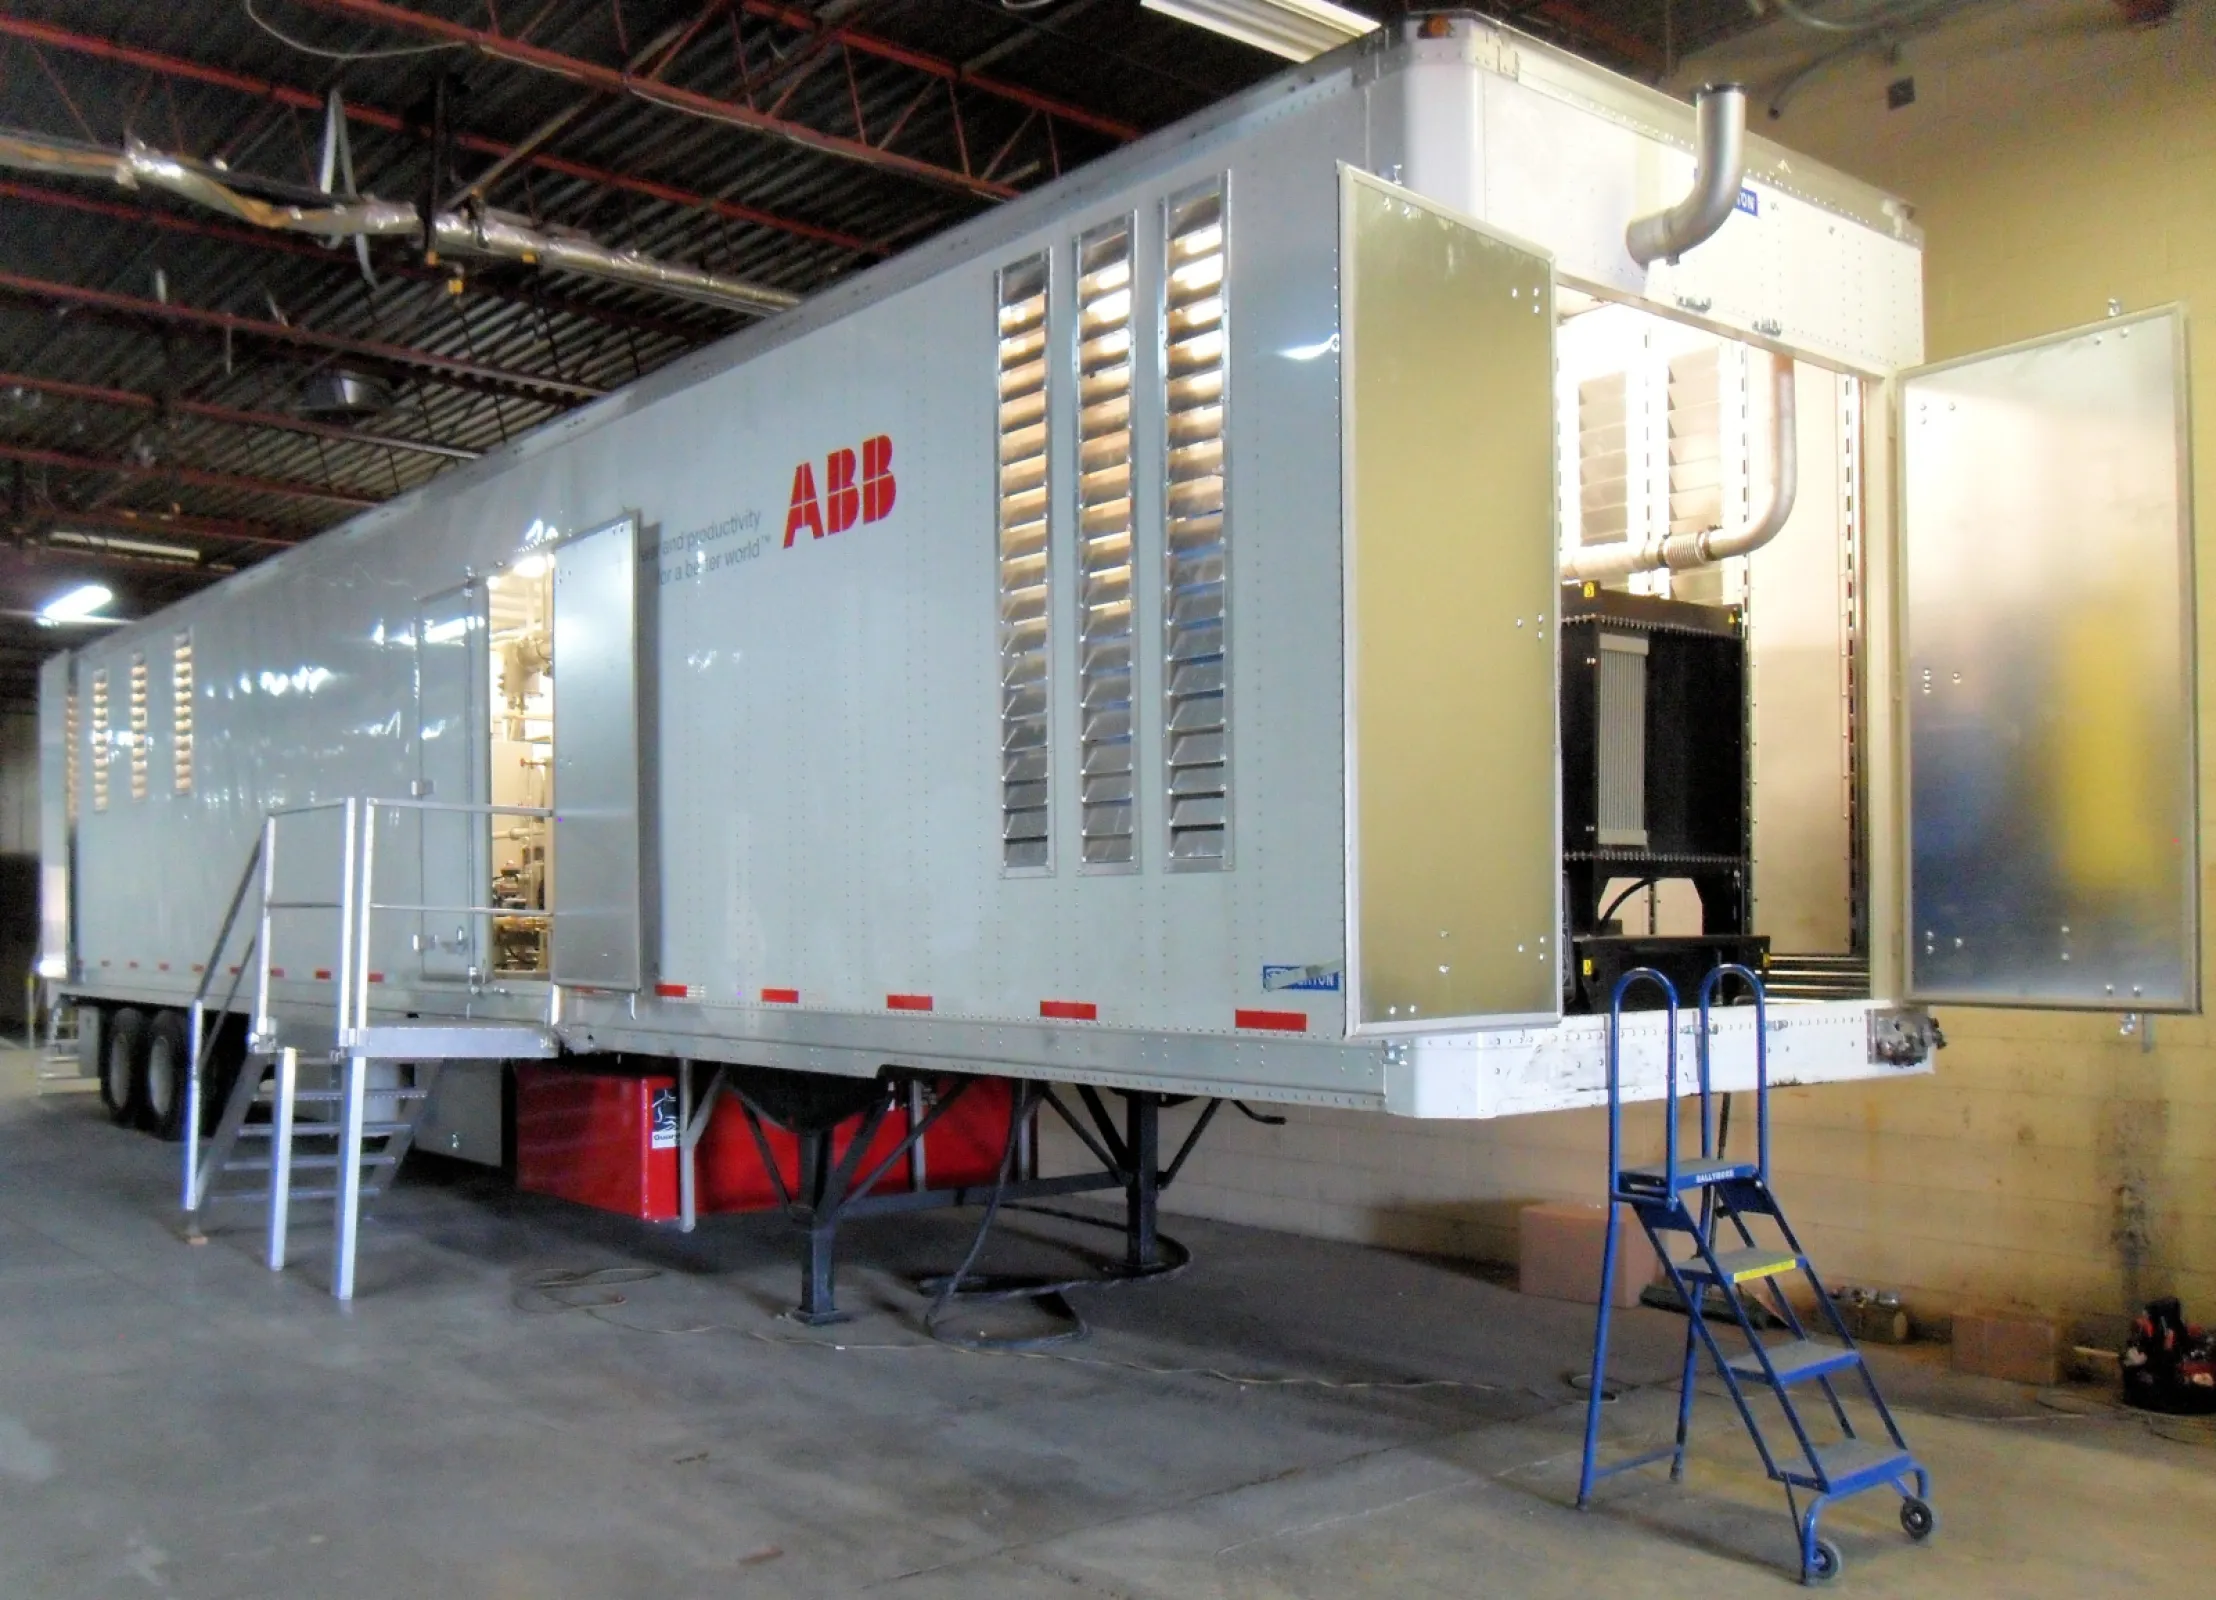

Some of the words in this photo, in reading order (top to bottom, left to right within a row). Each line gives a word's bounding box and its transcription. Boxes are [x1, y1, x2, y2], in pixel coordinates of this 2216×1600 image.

[783, 434, 897, 549] ABB
[662, 531, 684, 555] and
[686, 508, 761, 552] productivity
[675, 566, 683, 581] a
[685, 554, 721, 578] beter
